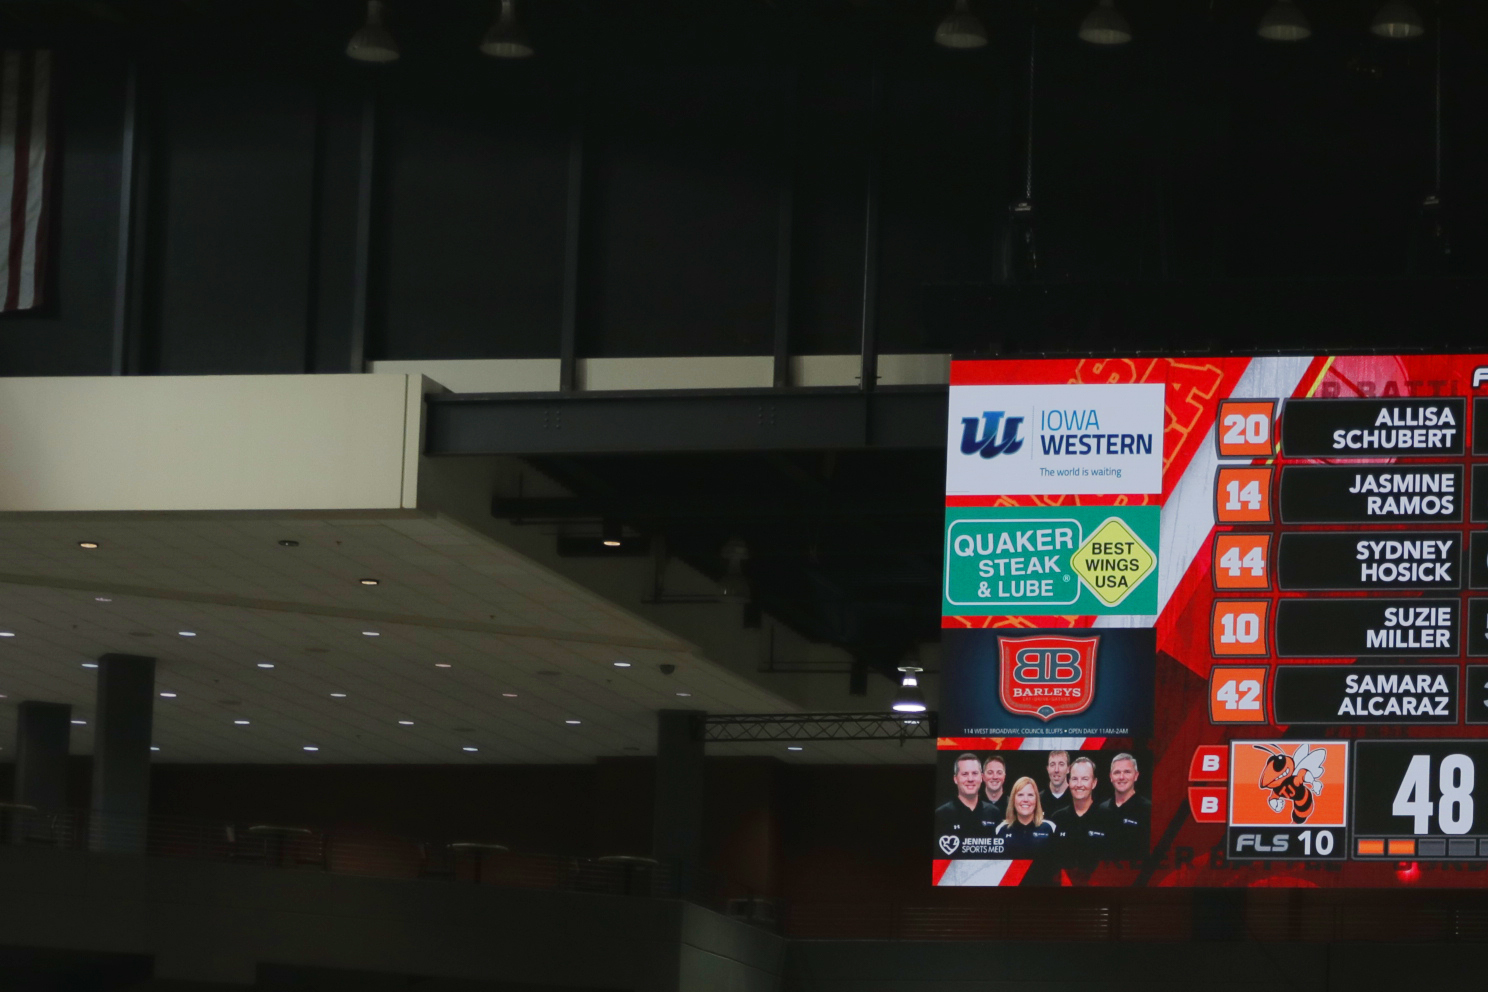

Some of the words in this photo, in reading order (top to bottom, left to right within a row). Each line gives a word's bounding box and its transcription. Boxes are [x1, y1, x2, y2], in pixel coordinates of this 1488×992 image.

[1040, 409, 1100, 431] IOWA
[1375, 408, 1455, 426] ALLISA
[1223, 414, 1269, 444] 20
[1040, 433, 1153, 455] WESTERN
[1332, 430, 1456, 449] SCHUBERT
[1040, 467, 1055, 477] The
[1056, 466, 1080, 477] world
[1082, 466, 1089, 477] is
[1090, 466, 1122, 478] waiting
[1349, 474, 1455, 494] JASMINE
[1225, 480, 1262, 510] 14
[1367, 496, 1454, 515] RAMOS
[954, 528, 1074, 557] QUAKER
[1091, 542, 1134, 555] BEST
[1356, 540, 1453, 560] SYDNEY
[978, 556, 1061, 577] STEAK
[1085, 559, 1140, 572] WINGS
[1220, 547, 1264, 576] 44
[1095, 575, 1129, 588] USA
[1360, 563, 1452, 582] HOSICK
[977, 582, 992, 598] &
[998, 580, 1054, 597] LUBE
[1384, 607, 1451, 627] SUZIE
[1220, 613, 1259, 643] 10
[1366, 630, 1451, 648] MILLER
[1013, 687, 1081, 698] BARLEYS
[1345, 674, 1449, 693] SAMARA
[1217, 680, 1261, 709] 42
[1337, 697, 1449, 716] ALCARAZ
[1201, 754, 1220, 772] B
[1392, 753, 1475, 835] 48
[1200, 796, 1219, 814] B
[961, 837, 991, 846] JENNIE
[993, 837, 1005, 845] ED
[961, 845, 986, 854] SPORTS
[986, 845, 1005, 853] MED
[1235, 834, 1289, 852] FLS
[1297, 830, 1334, 855] 10
